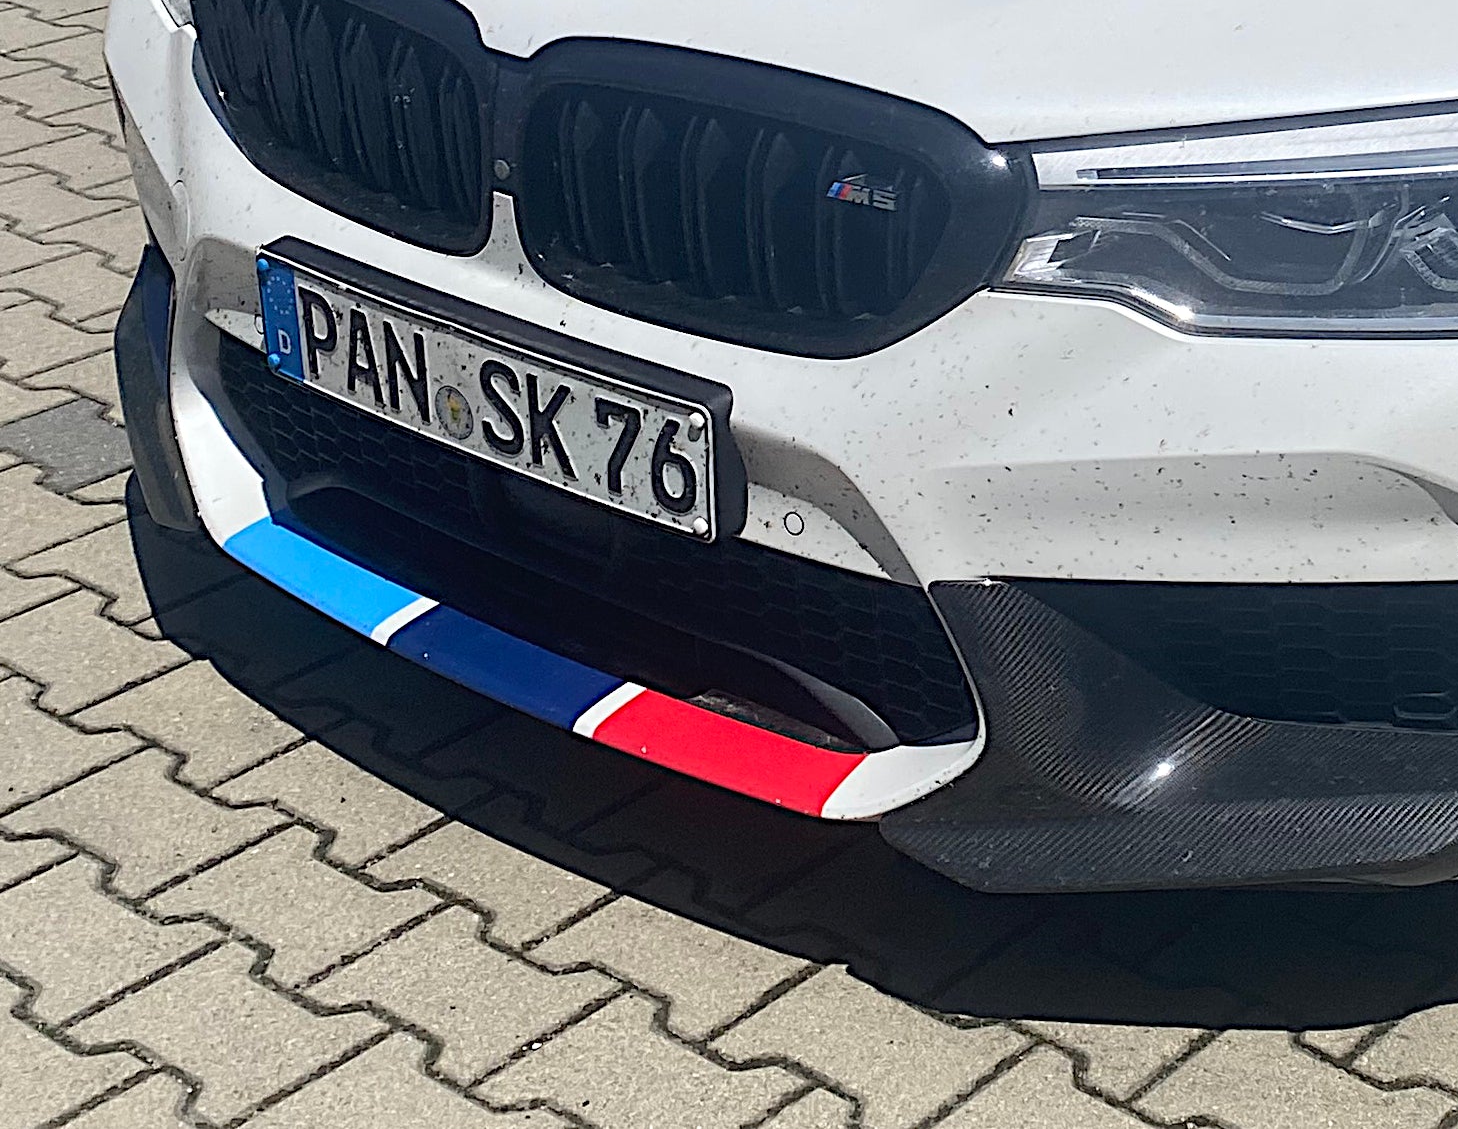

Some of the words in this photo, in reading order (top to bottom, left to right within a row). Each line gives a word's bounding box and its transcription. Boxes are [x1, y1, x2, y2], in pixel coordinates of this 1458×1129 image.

[278, 329, 291, 354] D
[299, 286, 432, 424] PAN
[480, 359, 578, 482] SK
[594, 396, 697, 514] 76
